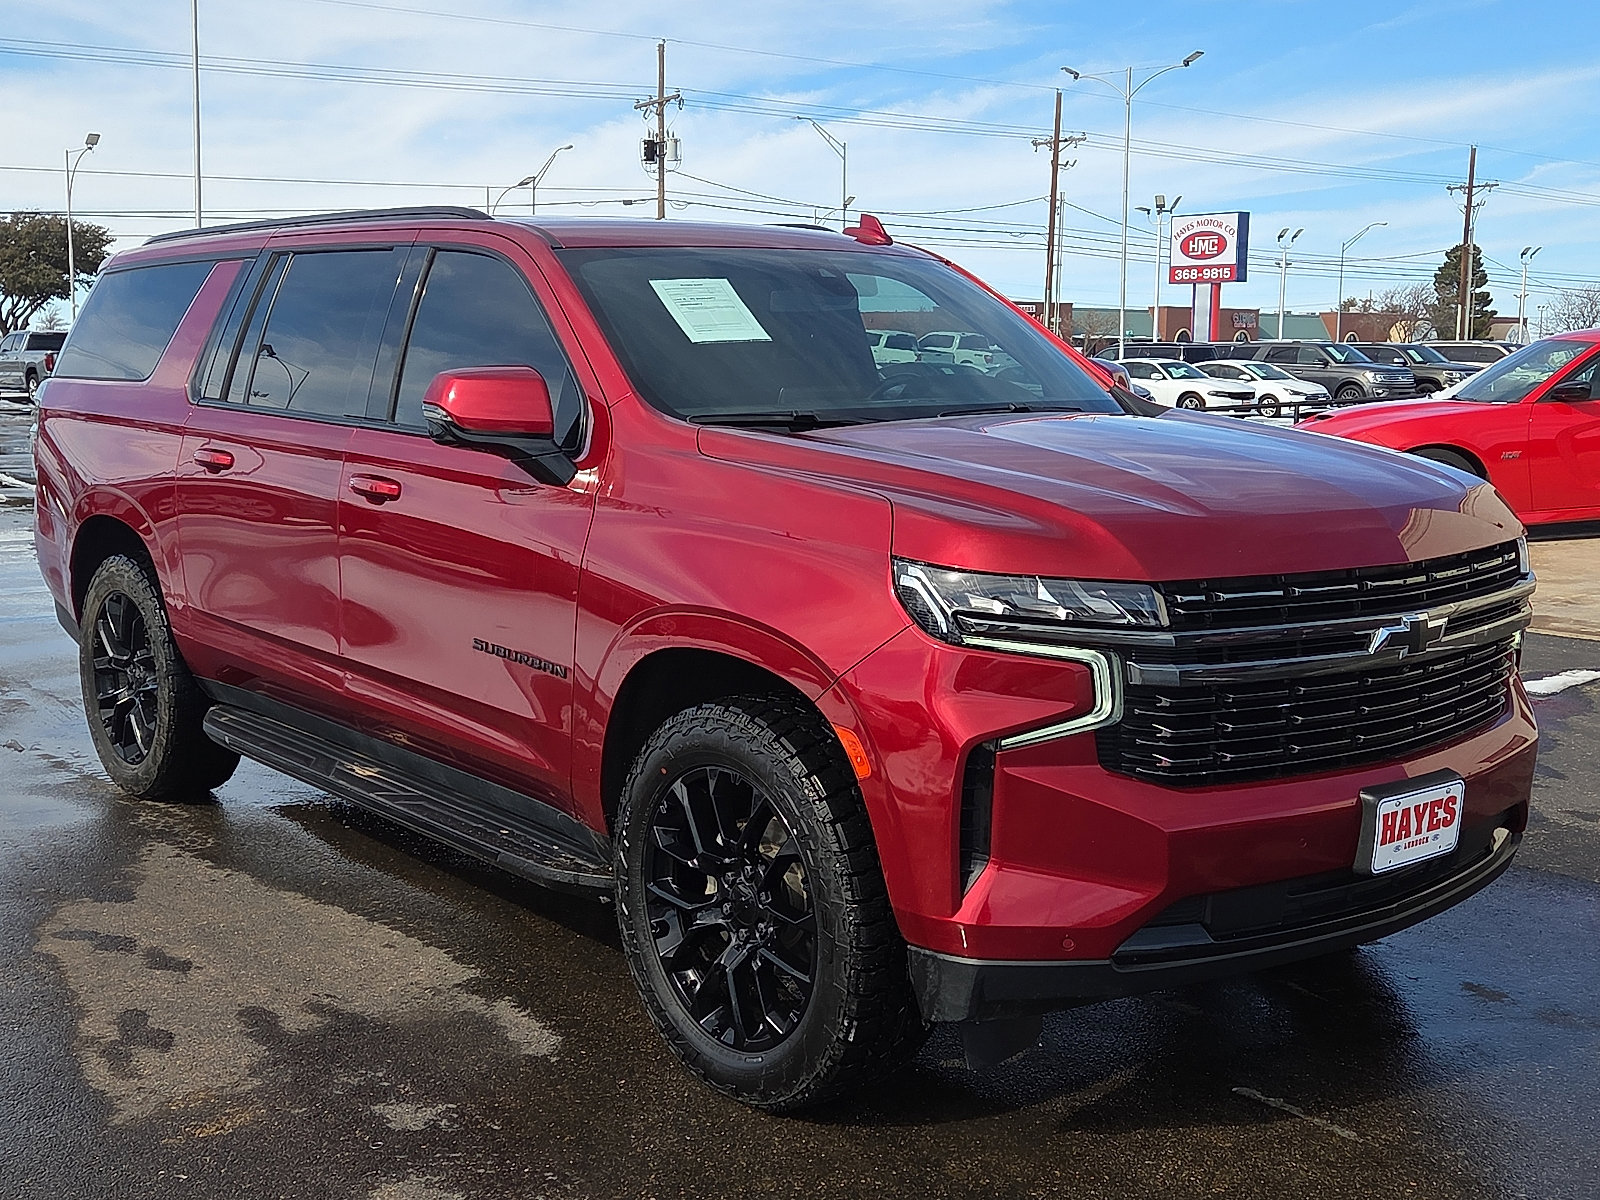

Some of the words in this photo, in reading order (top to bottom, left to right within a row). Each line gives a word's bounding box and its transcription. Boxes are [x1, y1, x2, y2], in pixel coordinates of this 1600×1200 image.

[1173, 222, 1195, 241] HAYES
[1196, 218, 1224, 230] MOTOR
[1224, 224, 1236, 238] CO.
[1188, 235, 1219, 256] HMC
[1174, 267, 1231, 281] 368-9815
[472, 637, 568, 680] SUBURBAN
[1379, 795, 1458, 847] HAYES
